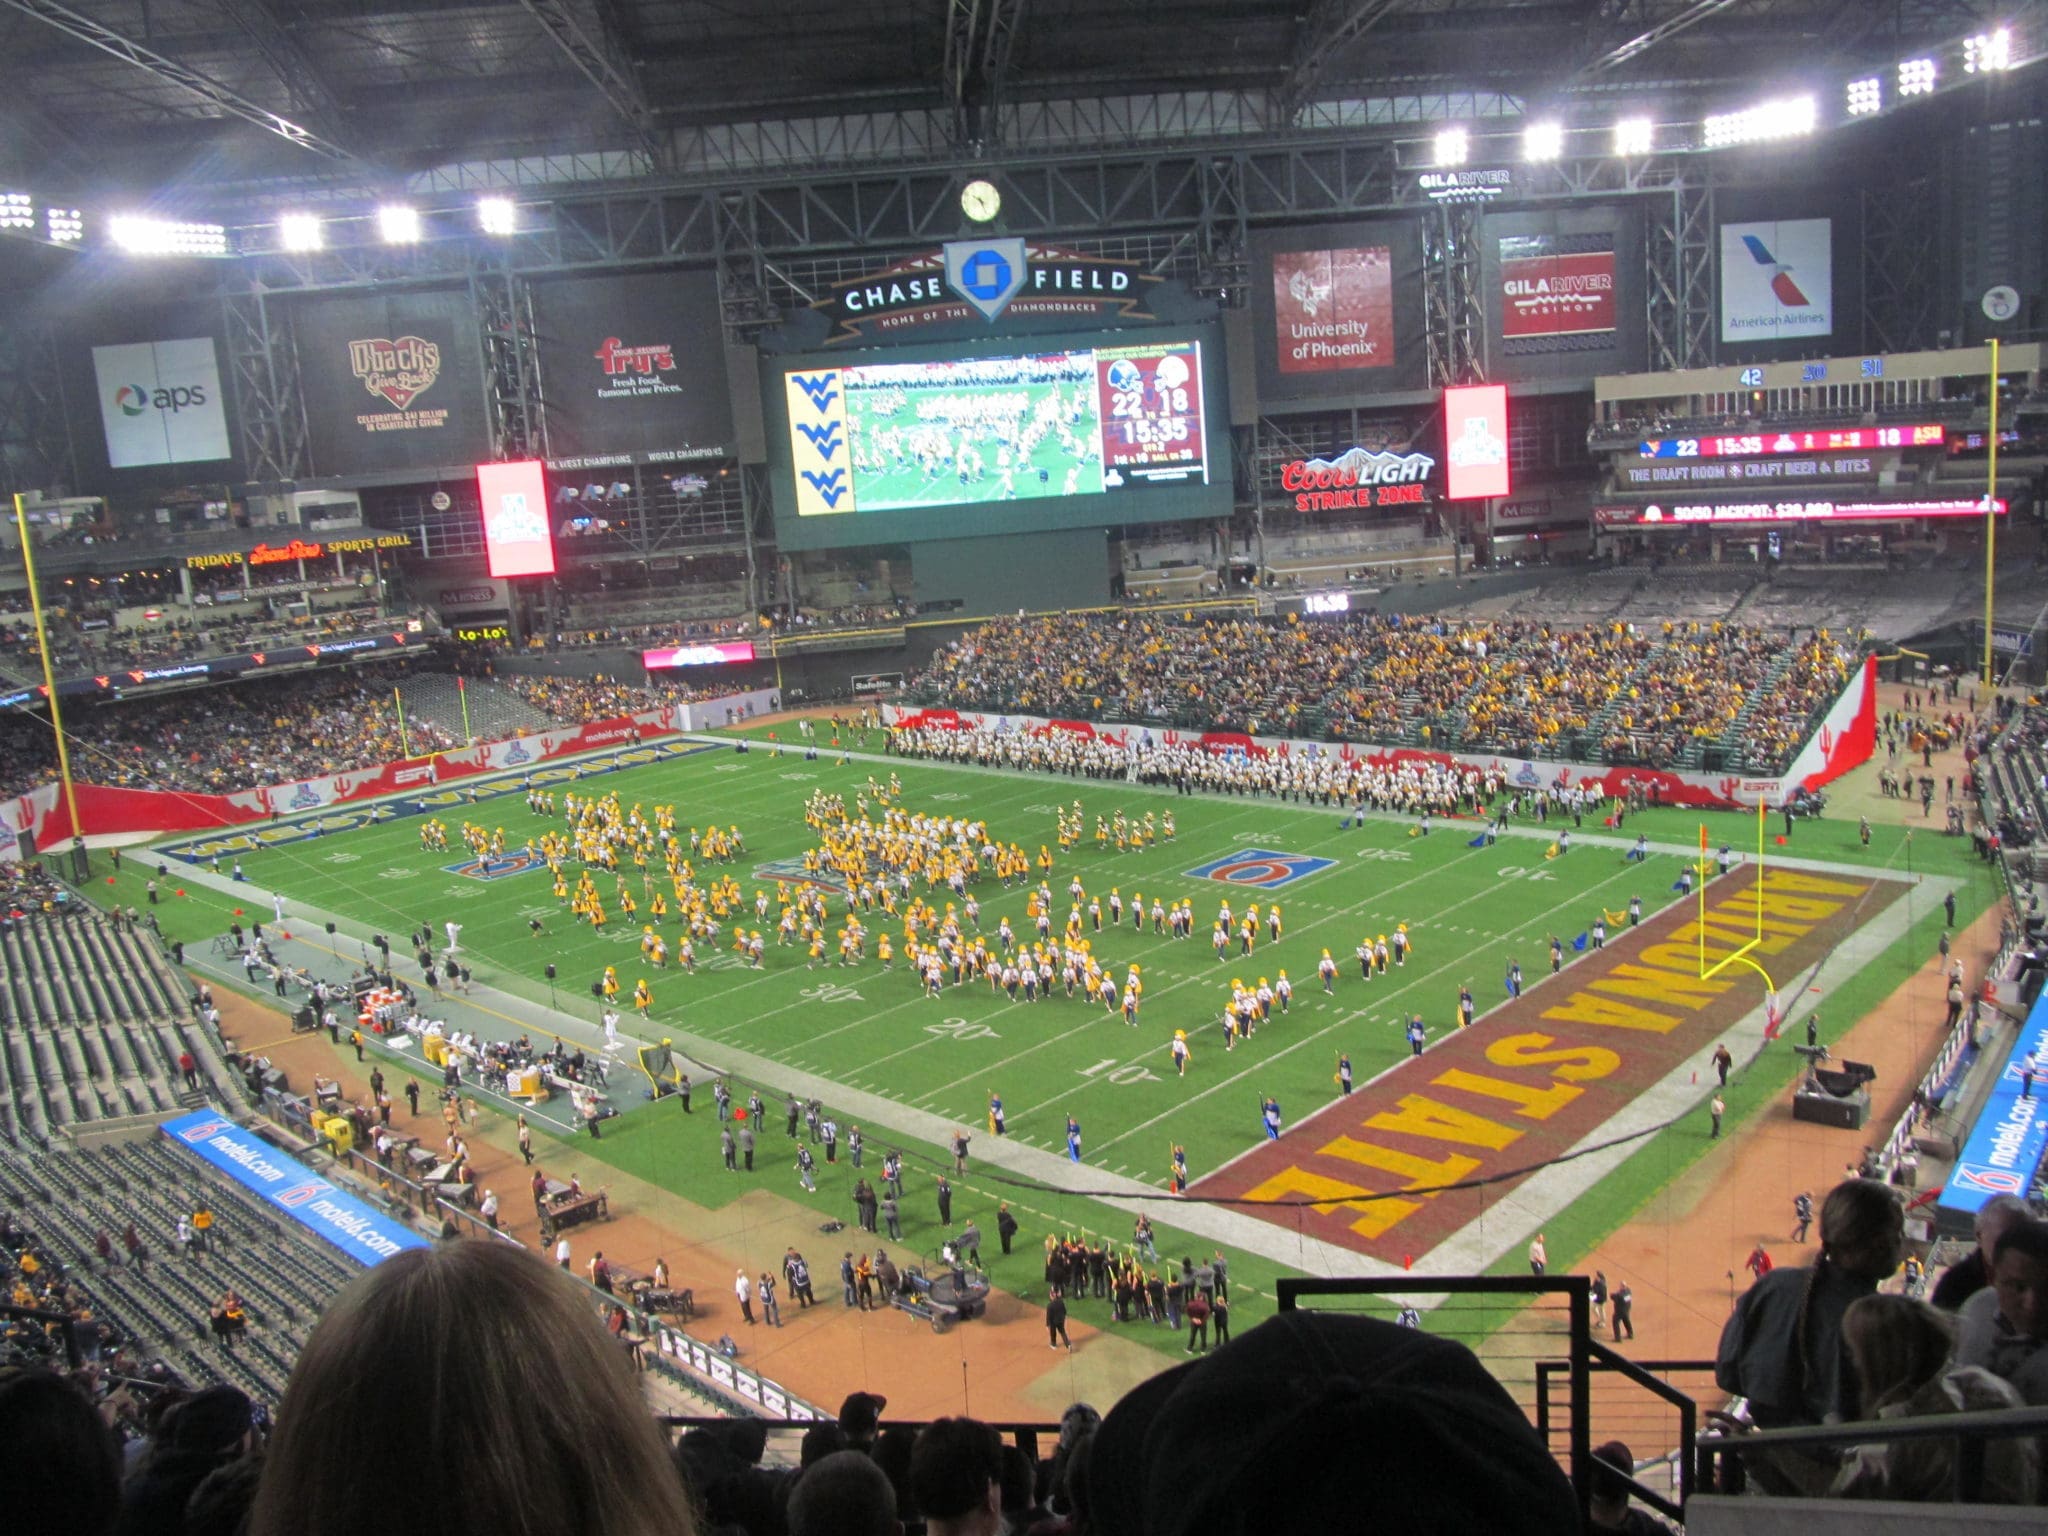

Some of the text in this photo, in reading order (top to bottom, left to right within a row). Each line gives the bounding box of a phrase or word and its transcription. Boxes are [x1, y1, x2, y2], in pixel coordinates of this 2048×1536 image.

[1419, 170, 1511, 189] GILA RIVER
[845, 270, 1129, 310] CHASE FIELD
[1504, 274, 1611, 296] GILA RIVER
[882, 303, 1097, 328] HOME OF THE DIAMONDBACKS
[1519, 304, 1594, 315] CASINOS
[1730, 313, 1824, 329] American Airlines
[1292, 319, 1368, 338] University
[594, 336, 677, 374] fry's
[1293, 343, 1309, 359] of
[613, 377, 636, 388] Fresh
[1741, 369, 1762, 386] 42
[153, 385, 206, 413] aps
[598, 387, 631, 398] Famous
[632, 386, 653, 396] Low
[1112, 388, 1188, 418] 22 18
[1124, 417, 1188, 444] 15:35
[1677, 439, 1699, 457] 22
[1716, 437, 1762, 455] 15:35
[1878, 428, 1901, 446] 18
[1914, 426, 1943, 443] ASU
[559, 458, 582, 469] WEST
[583, 455, 632, 467] CHAMPIONS
[648, 447, 723, 461] WORLD CHAMPIONS
[1281, 460, 1435, 491] Coors LIGHT
[1628, 468, 1650, 482] THE
[1653, 466, 1690, 481] DRAFT
[1692, 465, 1726, 480] ROOM
[1745, 462, 1783, 477] CRAFT
[1785, 460, 1816, 475] BEER
[1834, 459, 1870, 473] BITES
[1296, 484, 1425, 512] STRIKE ZONE
[327, 538, 375, 553] SPORTS
[377, 535, 411, 547] GRILL
[855, 681, 892, 690] Safelite
[1744, 781, 1780, 792] ESPN
[923, 1018, 1002, 1041] 20
[1240, 869, 1870, 1240] ARIZONA STATE
[1075, 1059, 1162, 1086] 10
[1989, 1095, 2039, 1168] motel6.com
[208, 1134, 286, 1182] motel6.com
[308, 1198, 402, 1256] motel6.com
